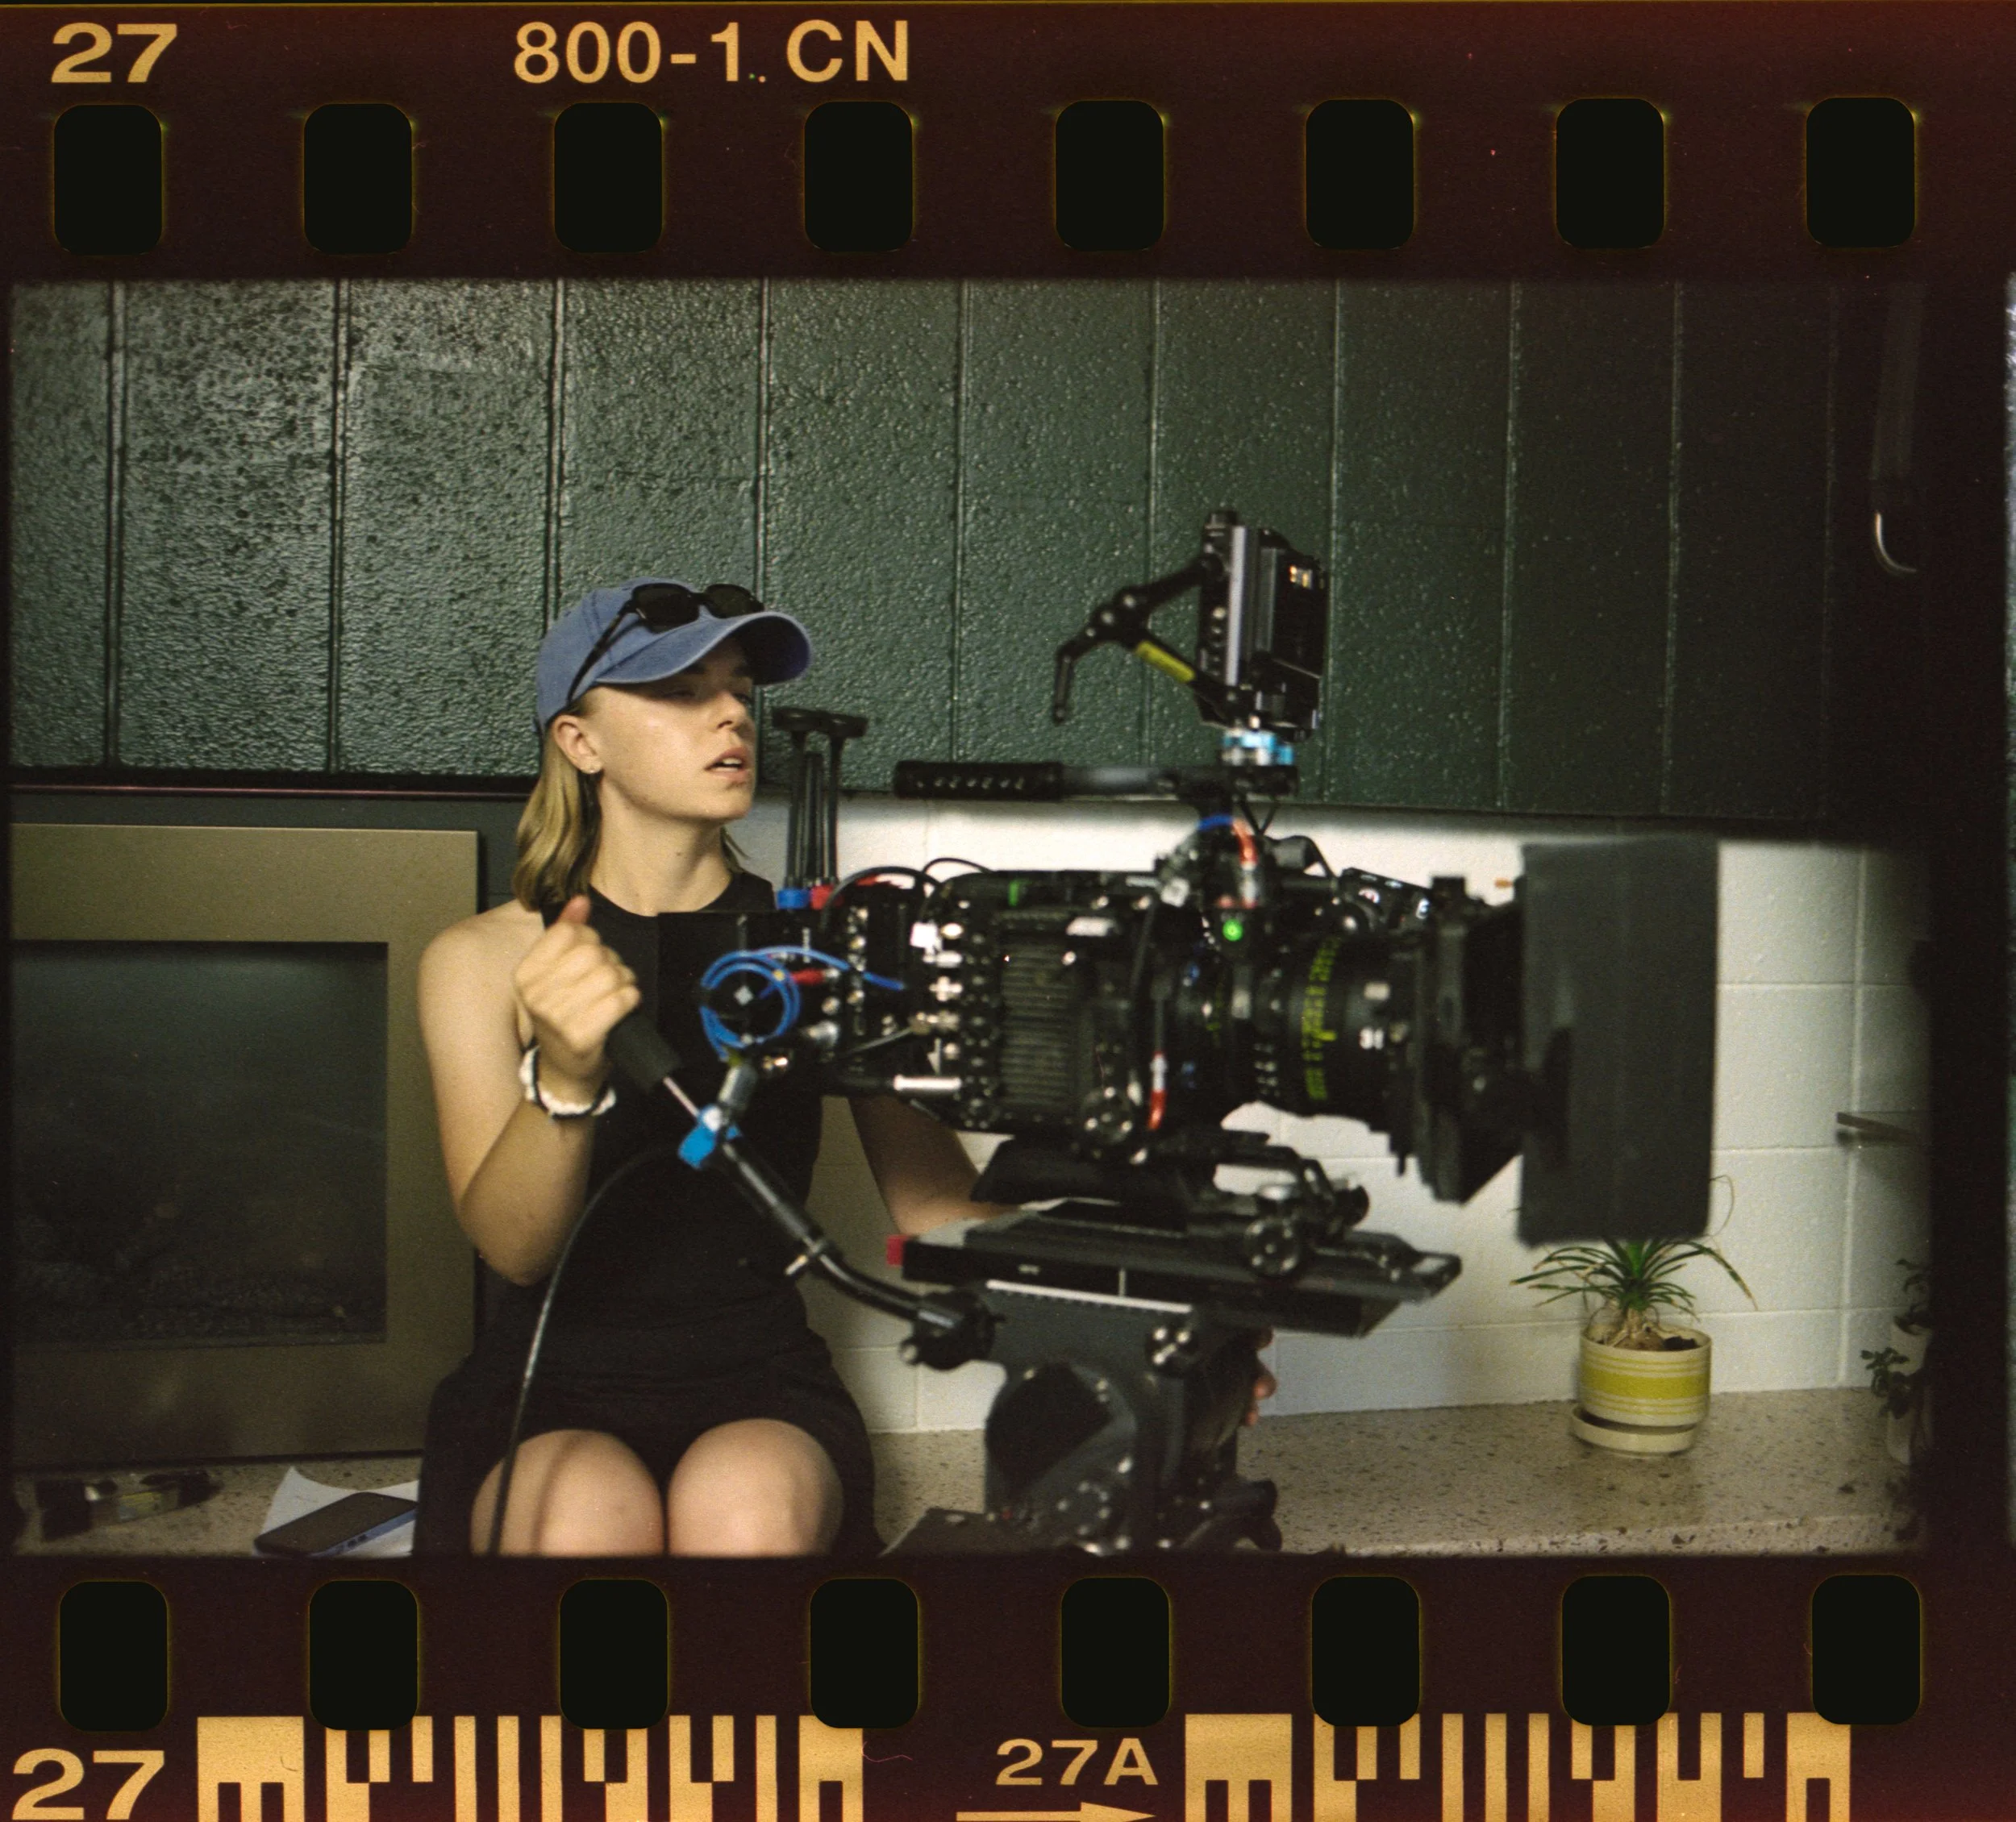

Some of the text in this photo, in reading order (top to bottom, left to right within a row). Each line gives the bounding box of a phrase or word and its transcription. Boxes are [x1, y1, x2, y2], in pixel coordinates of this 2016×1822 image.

[51, 22, 177, 83] 27
[786, 19, 908, 83] CN
[11, 1748, 165, 1821] 27
[996, 1737, 1158, 1786] 27A
